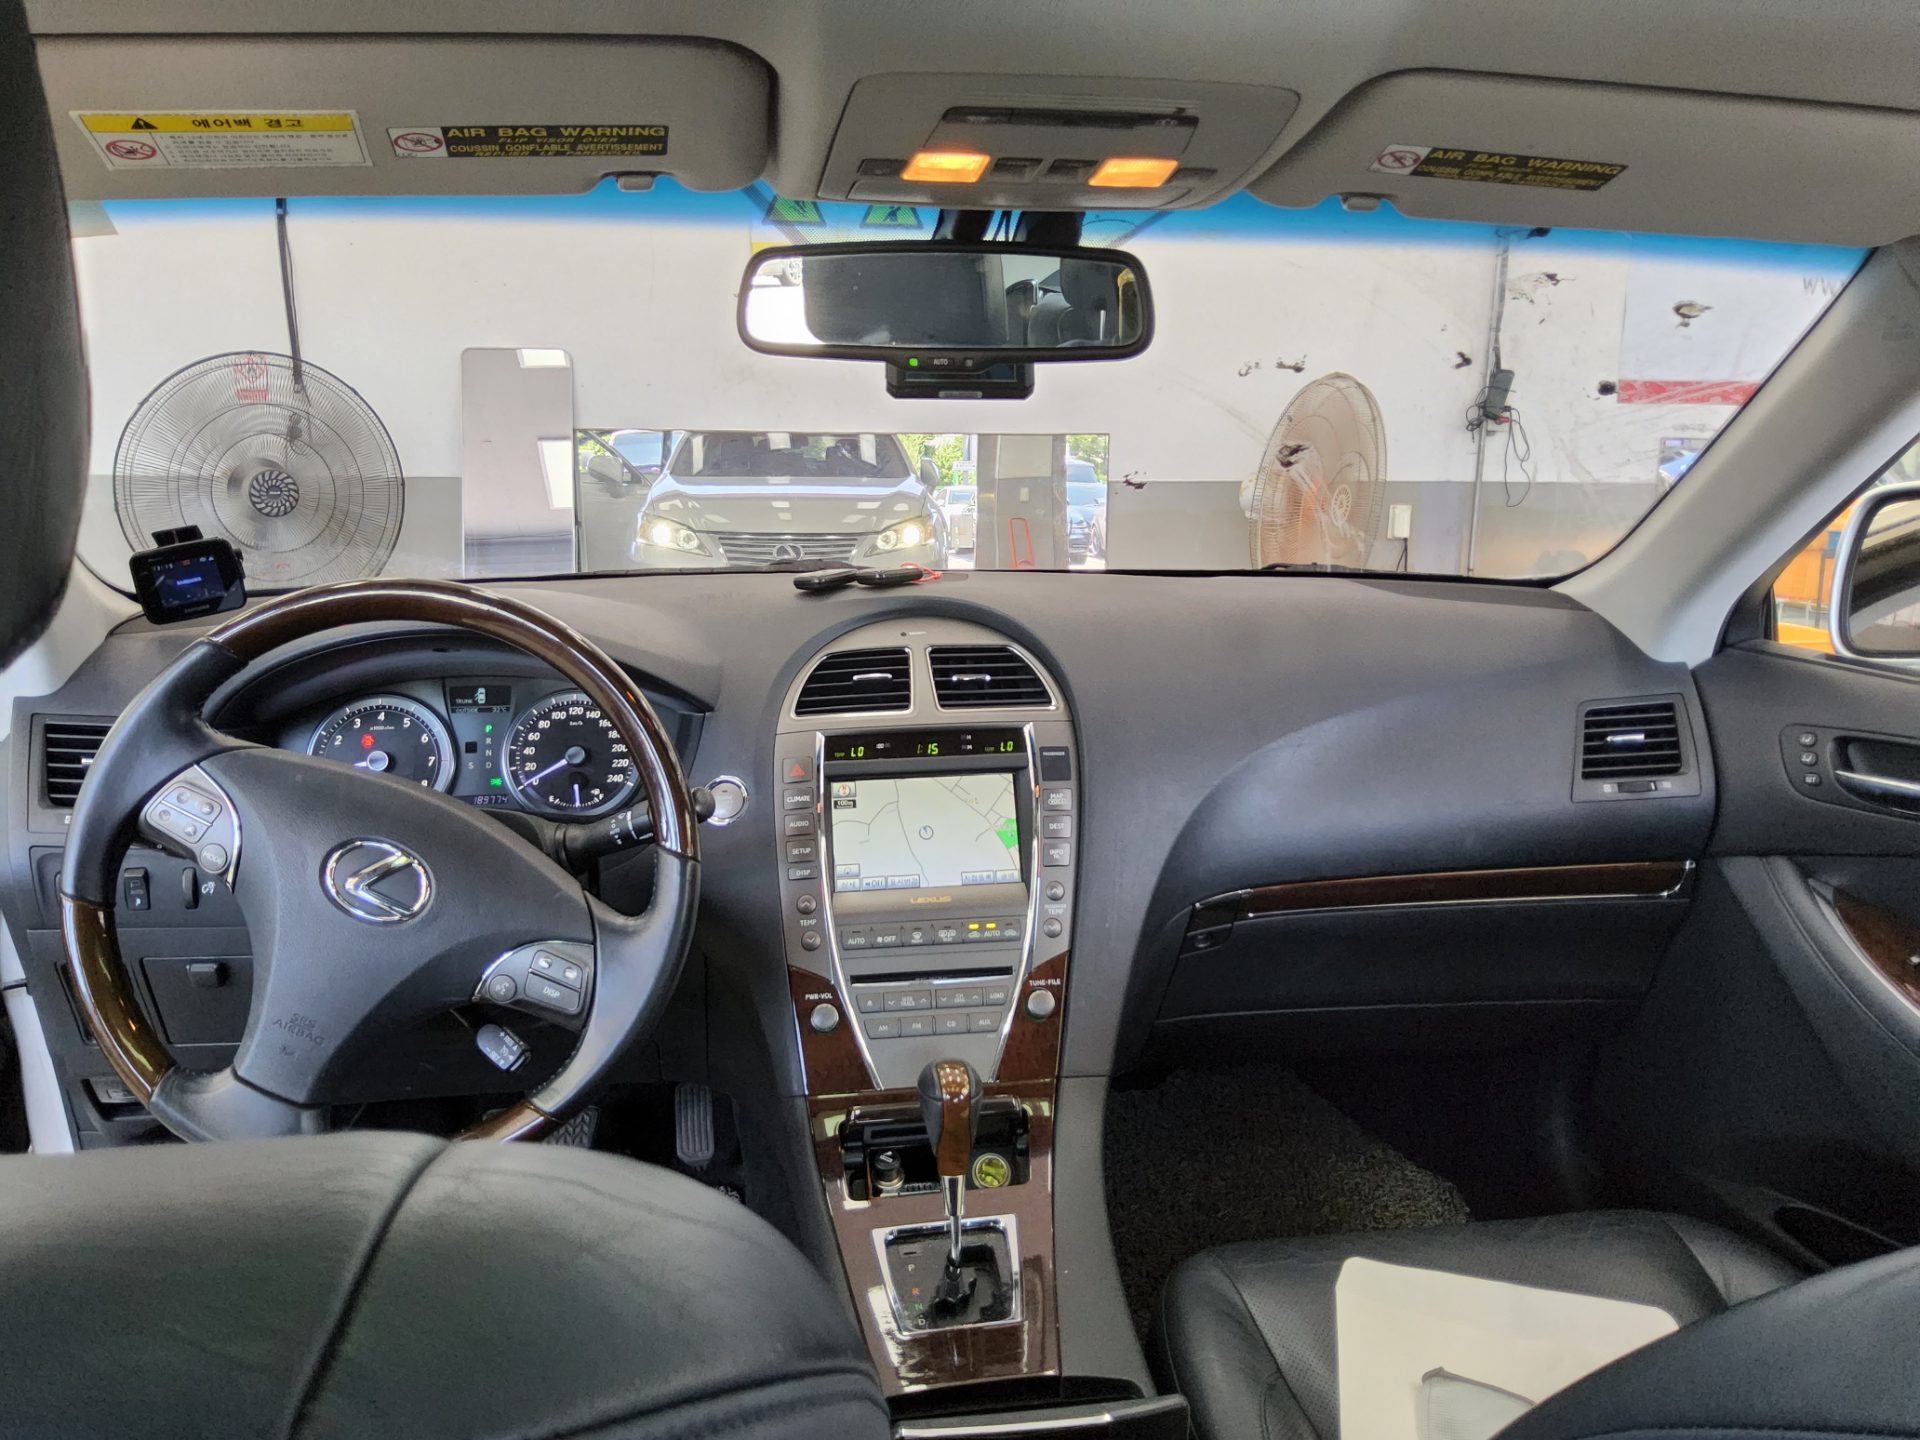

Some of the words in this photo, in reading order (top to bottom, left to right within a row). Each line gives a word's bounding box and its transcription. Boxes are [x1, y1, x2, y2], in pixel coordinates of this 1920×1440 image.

[192, 118, 251, 128] 에어백
[447, 128, 486, 137] AIR
[498, 127, 547, 136] BAG
[560, 127, 665, 136] WARNING
[505, 144, 571, 152] GONFLABLE
[576, 143, 664, 151] AVERTISSEMENT
[1430, 150, 1466, 160] AIR
[1472, 153, 1517, 165] BAG
[1527, 158, 1622, 175] WARNING
[933, 358, 949, 366] AUTO
[569, 706, 584, 715] 120
[585, 710, 601, 719] 140
[377, 711, 385, 721] 4
[551, 711, 567, 720] 100
[353, 718, 361, 728] 3
[403, 717, 411, 728] 5
[538, 720, 550, 729] 80
[485, 724, 493, 733] P
[421, 733, 429, 743] 6
[528, 732, 540, 741] 60
[608, 730, 620, 739] 18
[334, 735, 343, 745] 2
[485, 737, 492, 745] R
[485, 749, 492, 757] N
[523, 746, 535, 755] 40
[428, 756, 436, 767] 7
[468, 762, 474, 770] S
[485, 761, 492, 769] D
[611, 758, 629, 767] 220
[524, 762, 537, 771] 20
[606, 774, 624, 783] 240
[786, 795, 811, 803] CLIMATE
[791, 847, 811, 855] SETUP
[909, 895, 952, 904] LEXUS
[799, 918, 817, 927] TEMP
[847, 937, 865, 945] AUTO
[883, 935, 896, 943] OFF
[542, 985, 561, 999] DISP
[912, 1022, 922, 1030] FM
[911, 1287, 921, 1295] R
[918, 1318, 926, 1326] D
